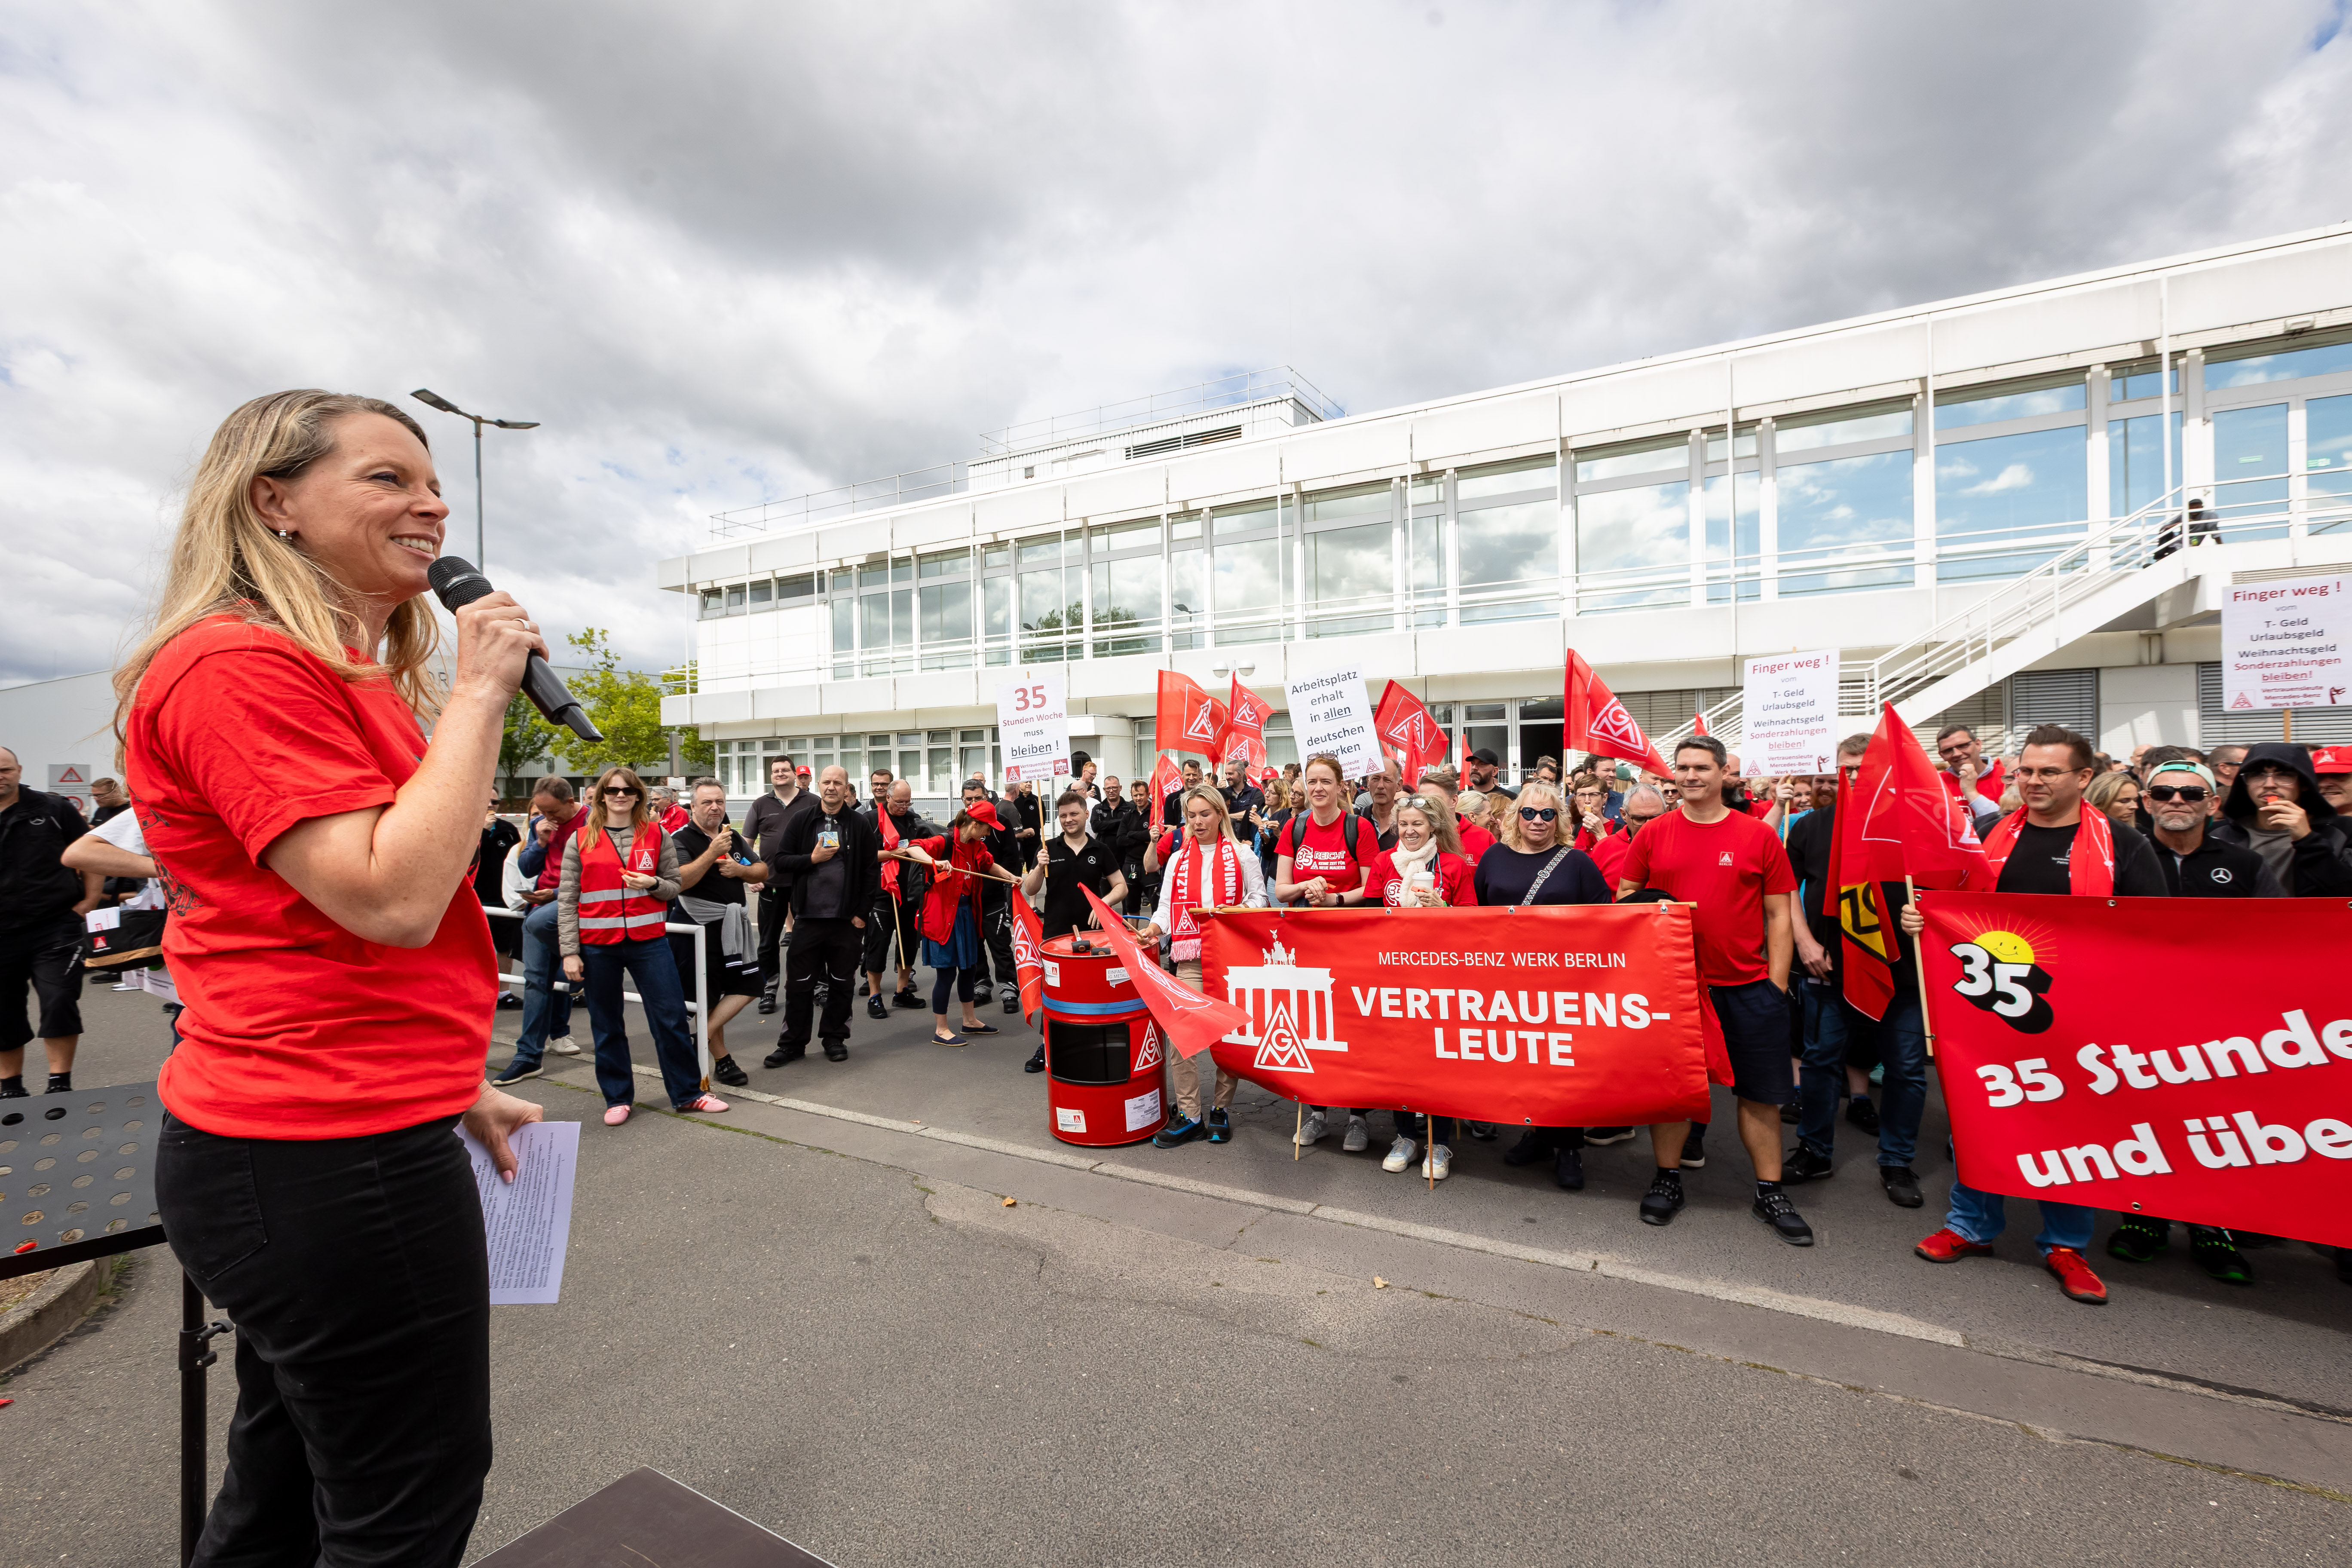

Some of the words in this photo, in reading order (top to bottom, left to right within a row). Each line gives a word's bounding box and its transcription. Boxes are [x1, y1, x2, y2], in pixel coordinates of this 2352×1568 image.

[2233, 589, 2287, 602] Finger
[2292, 585, 2329, 596] weg
[2280, 618, 2309, 627] Geld
[2250, 629, 2324, 642] Urlaubsgeld
[2239, 643, 2337, 658] Weihnachtsgeld
[1753, 663, 1790, 674] Finger
[1794, 658, 1820, 668] weg
[2234, 657, 2341, 671] Sonderzahlungen
[1292, 671, 1358, 695] Arbeitsplatz
[1015, 685, 1046, 711] 35
[1311, 690, 1344, 706] erhalt
[1784, 689, 1804, 697] Geld
[1763, 699, 1815, 711] Urlaubsgeld
[1003, 717, 1034, 726] Stunden
[1036, 712, 1063, 721] Woche
[1310, 714, 1320, 723] in
[1324, 707, 1351, 720] allen
[1754, 714, 1824, 727] Weihnachtsgeld
[1307, 726, 1365, 746] deutschen
[1750, 728, 1826, 739] Sonderzahlungen
[1011, 744, 1051, 756] bleiben
[1769, 740, 1805, 749] bleiben!
[1314, 851, 1346, 860] REICHT
[1222, 845, 1236, 905] GEWINNT
[1379, 951, 1505, 967] MERCEDES-BENZ
[1511, 952, 1560, 968] WERK
[1565, 952, 1626, 968] BERLIN
[1949, 942, 2033, 1018] 35
[1351, 986, 1671, 1029] VERTRAUENS-
[1435, 1027, 1575, 1067] LEUTE
[1976, 1057, 2064, 1108] 35
[2016, 1122, 2173, 1188] und
